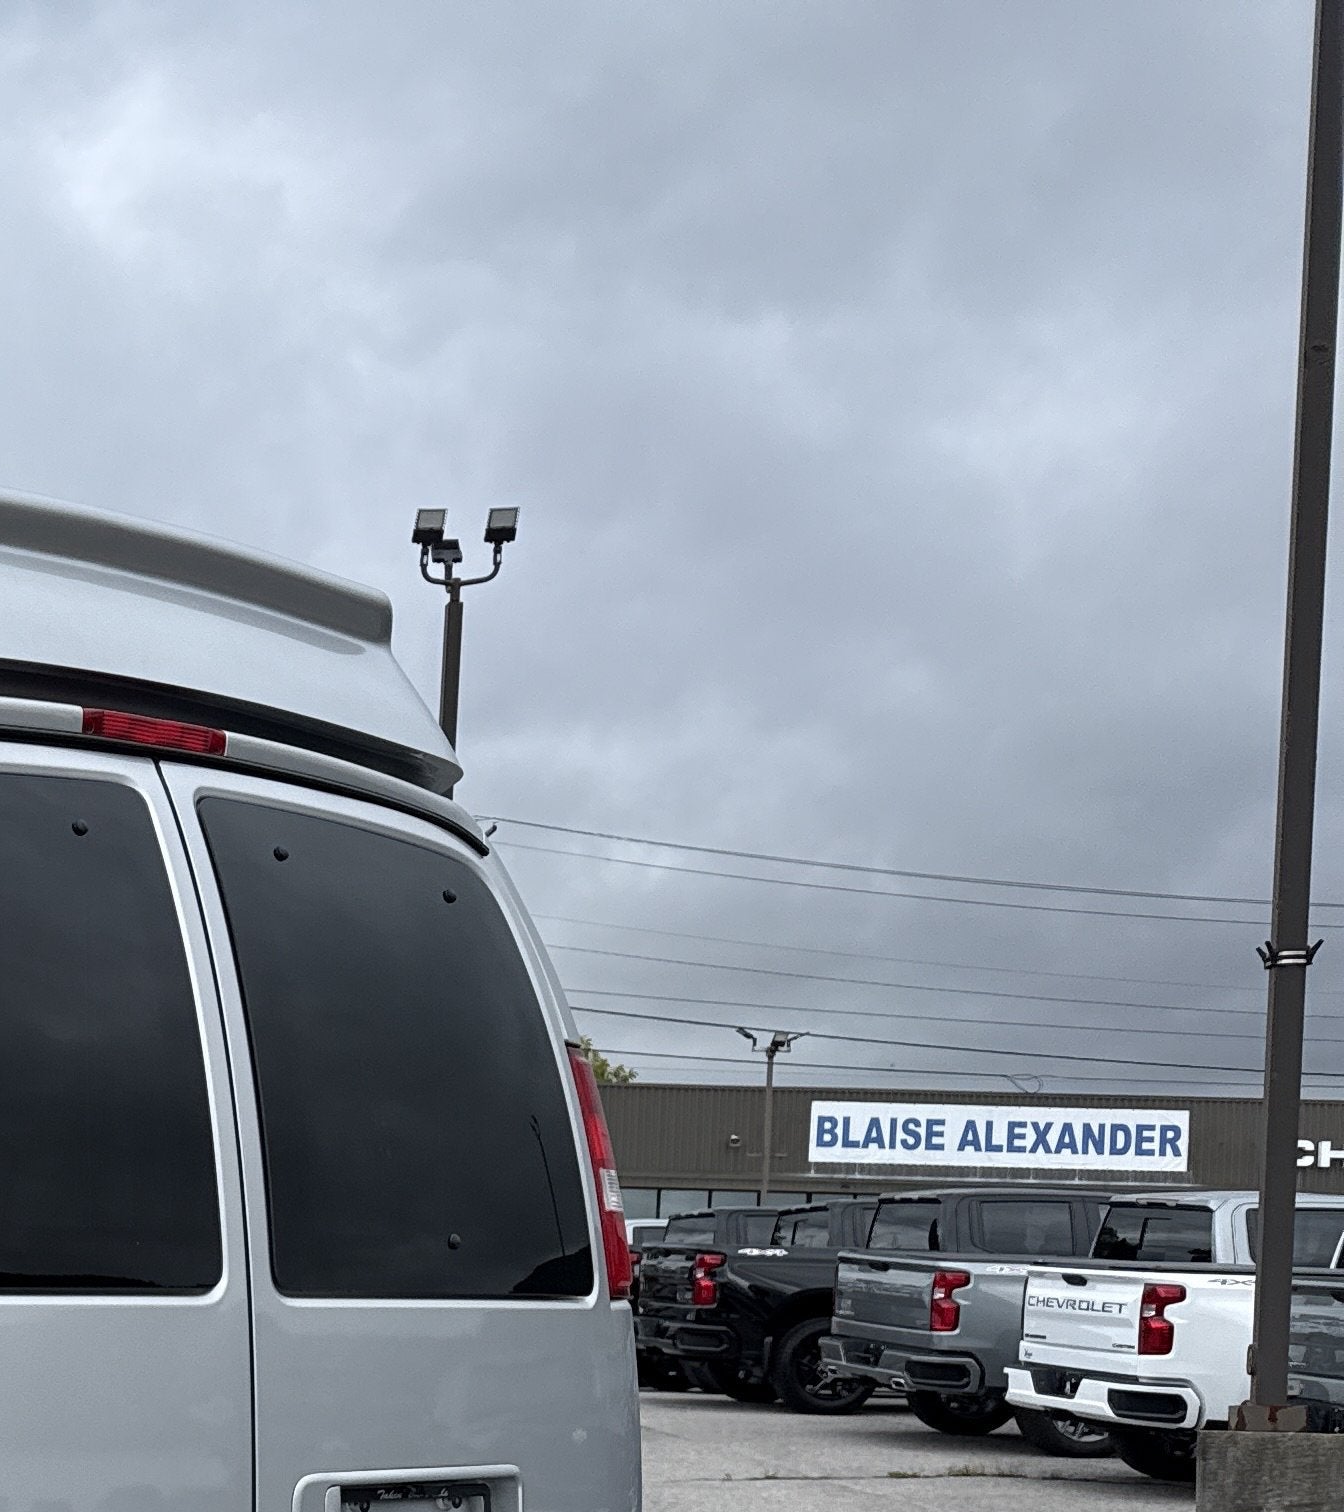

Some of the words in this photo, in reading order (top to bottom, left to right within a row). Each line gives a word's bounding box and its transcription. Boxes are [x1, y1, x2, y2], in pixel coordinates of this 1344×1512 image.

[816, 1115, 946, 1152] BLAISE
[957, 1119, 1183, 1158] ALEXANDER
[1027, 1295, 1128, 1314] CHEVROLET
